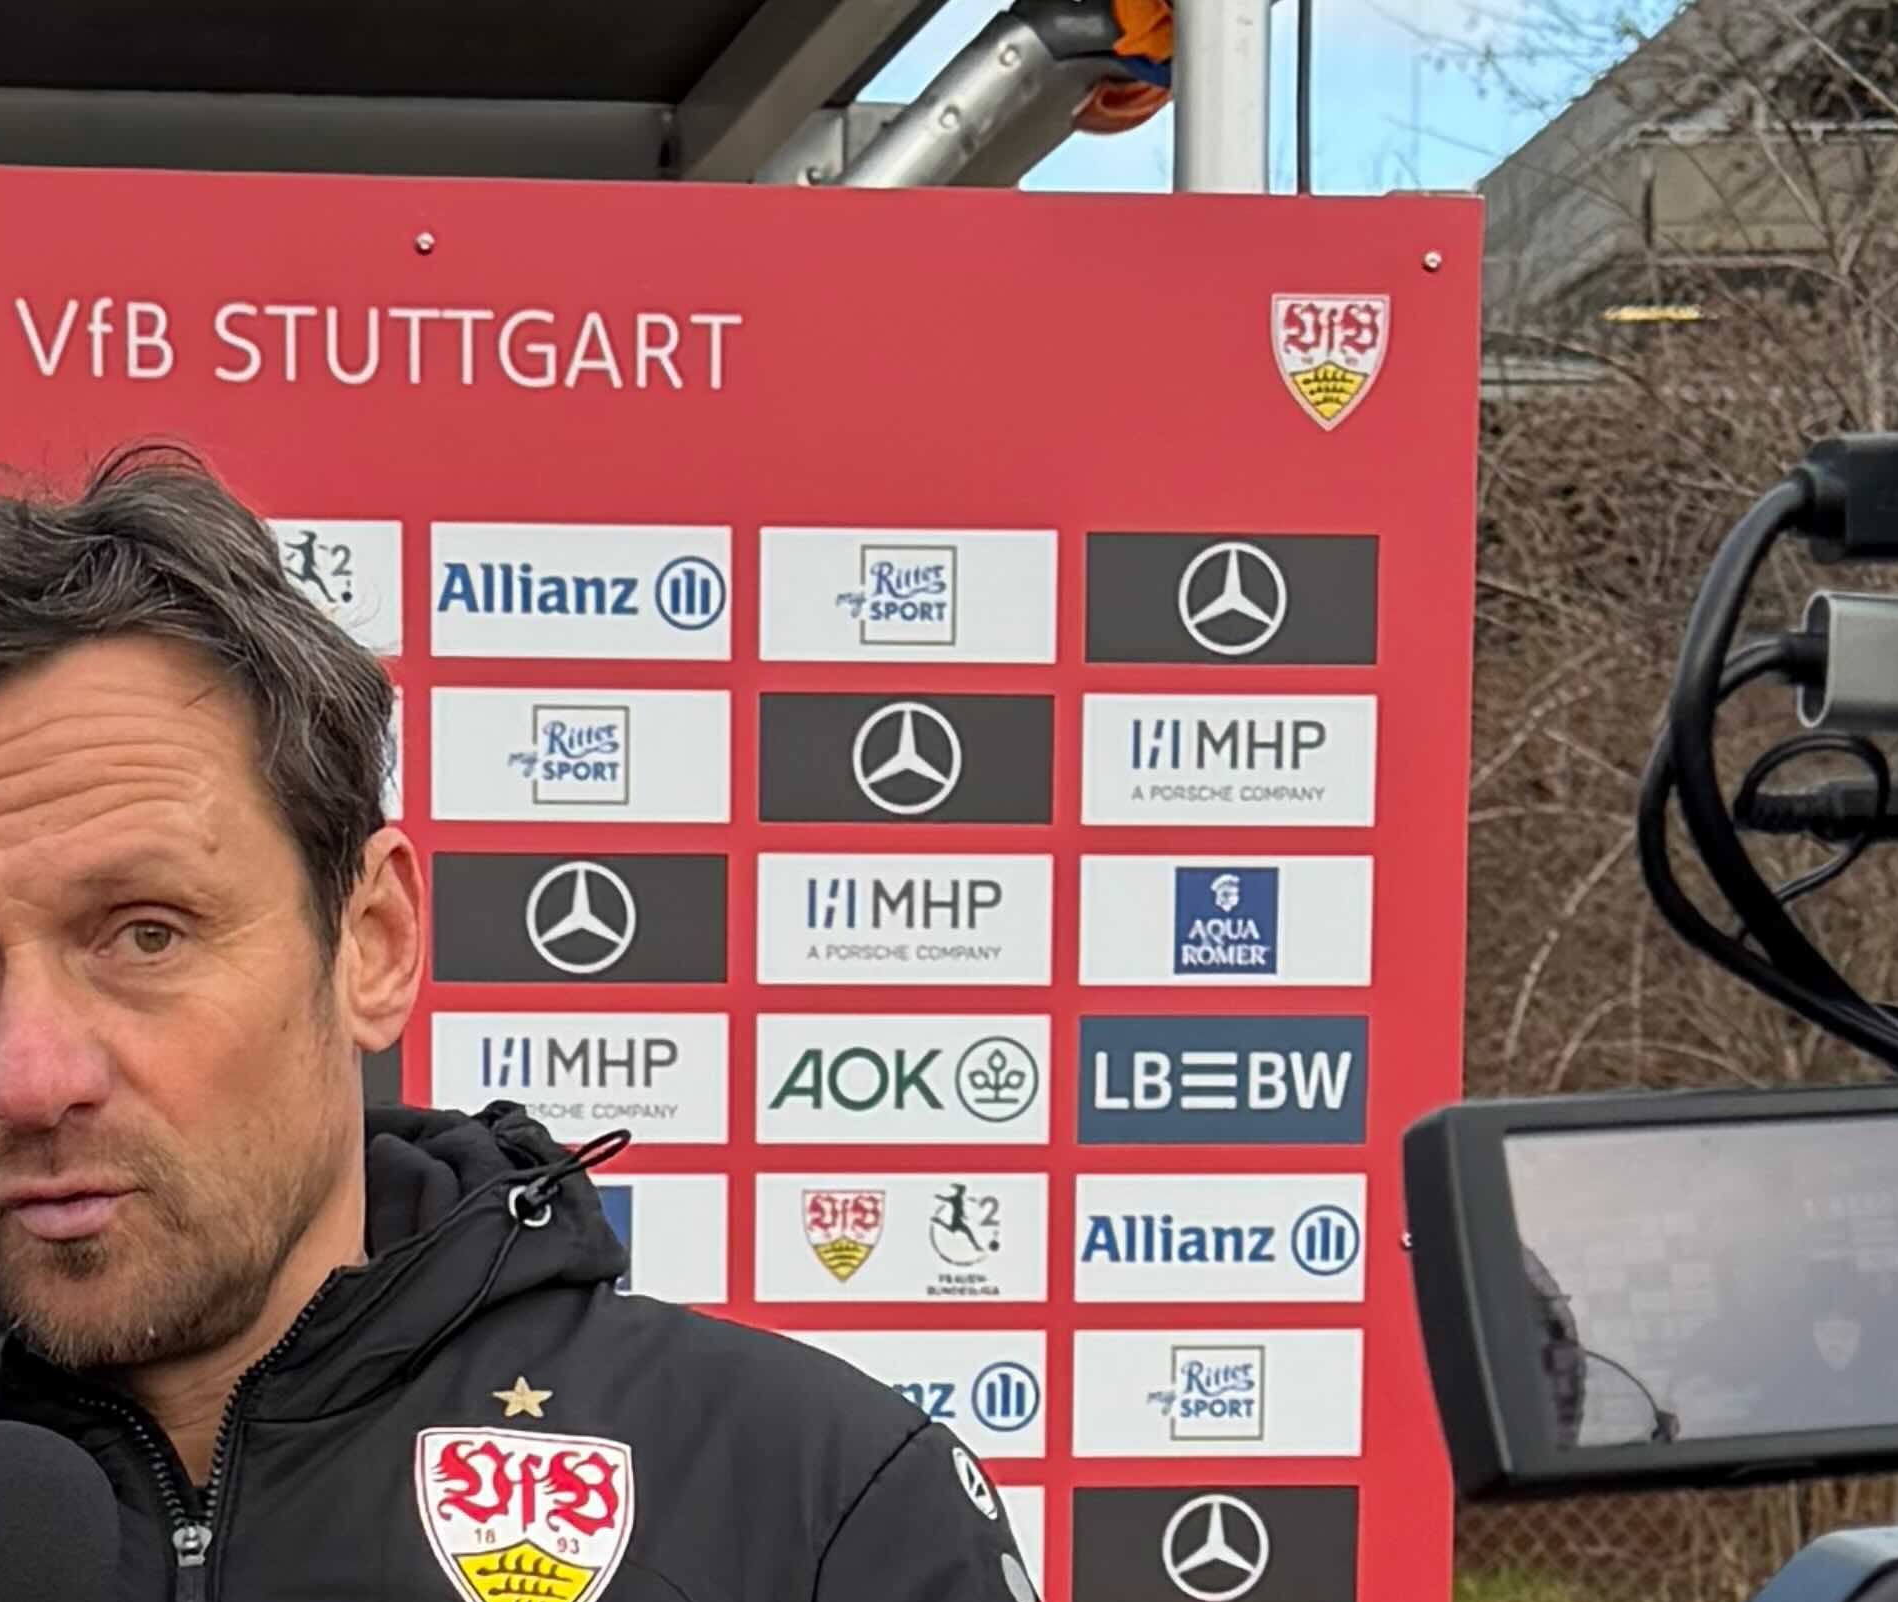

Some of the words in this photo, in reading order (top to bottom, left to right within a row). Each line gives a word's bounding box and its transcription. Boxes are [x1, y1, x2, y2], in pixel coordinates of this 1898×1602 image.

[15, 297, 174, 378] VfB
[214, 303, 742, 390] STUTTGART
[438, 563, 638, 615] Allianz
[871, 562, 946, 599] Ritter
[870, 597, 946, 621] SPORT
[544, 721, 619, 759] Ritter
[1197, 720, 1325, 769] MHP
[543, 757, 619, 781] SPORT
[1150, 785, 1233, 802] PORSCHE
[1240, 786, 1325, 801] COMPANY
[872, 880, 1002, 929] MHP
[1189, 919, 1259, 943] AQUA
[826, 944, 909, 961] PORSCHE
[916, 945, 1001, 960] COMPANY
[546, 1037, 678, 1087] MHP
[769, 1047, 943, 1111] AOK
[1082, 1215, 1275, 1262] Allianz
[1181, 1361, 1255, 1397] Ritter
[1181, 1395, 1254, 1418] SPORT
[433, 1440, 620, 1537] VfB
[474, 1528, 496, 1544] 18
[557, 1538, 580, 1554] 93
